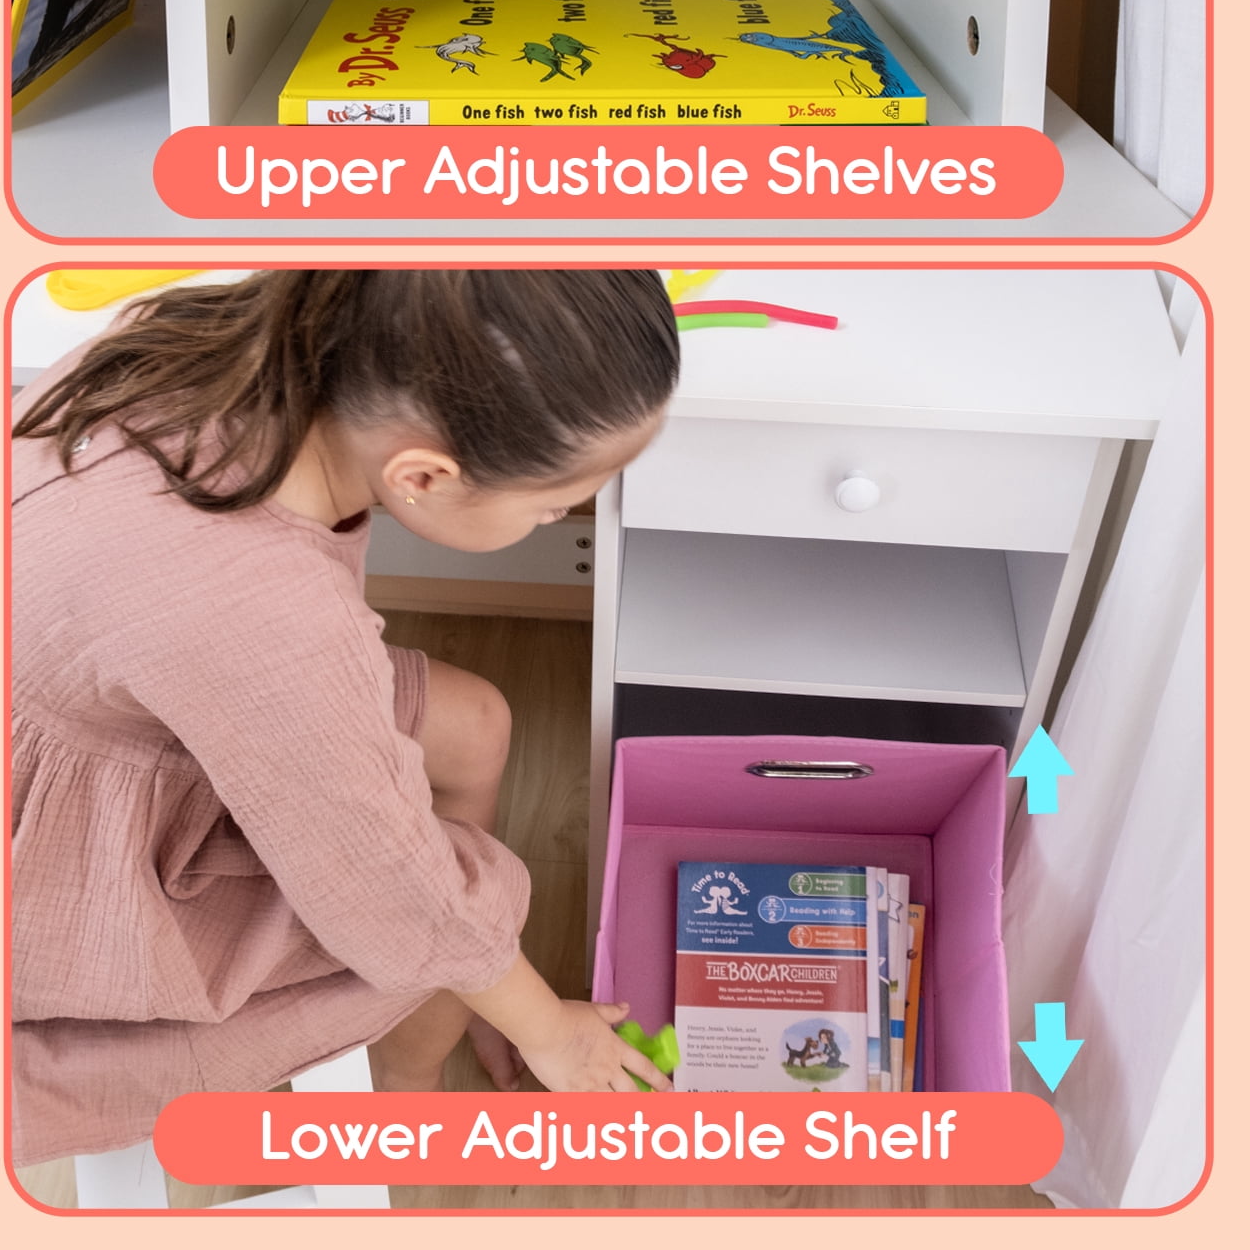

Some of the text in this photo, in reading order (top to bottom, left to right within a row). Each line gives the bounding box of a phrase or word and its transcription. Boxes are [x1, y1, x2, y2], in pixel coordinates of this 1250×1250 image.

[459, 4, 495, 26] One
[557, 3, 587, 22] two
[642, 8, 678, 26] red
[736, 2, 771, 25] blue
[462, 104, 742, 119] One fish two fish red fish blue fish
[787, 103, 837, 119] Dr. Seuss
[691, 870, 751, 895] Time to Read
[768, 911, 776, 922] 2
[790, 907, 856, 916] Reading with Help
[707, 961, 837, 983] THE BOXCAR CHILDREN
